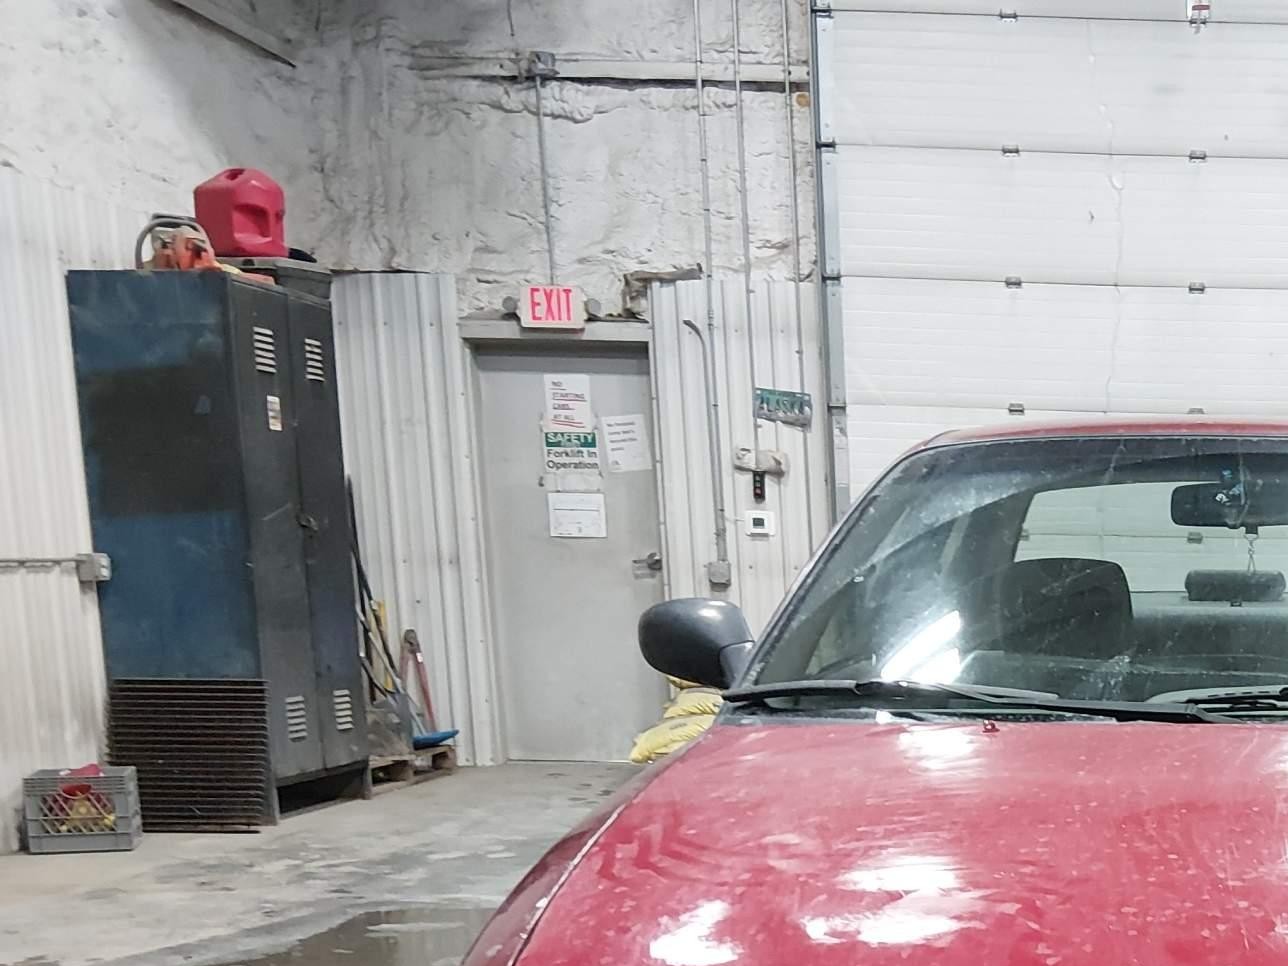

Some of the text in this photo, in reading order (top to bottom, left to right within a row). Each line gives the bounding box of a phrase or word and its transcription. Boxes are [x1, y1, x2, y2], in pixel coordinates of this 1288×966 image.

[530, 288, 572, 321] EXIT
[547, 433, 593, 443] SAFETY
[547, 449, 598, 459] Forklift In
[546, 460, 600, 470] Operation
